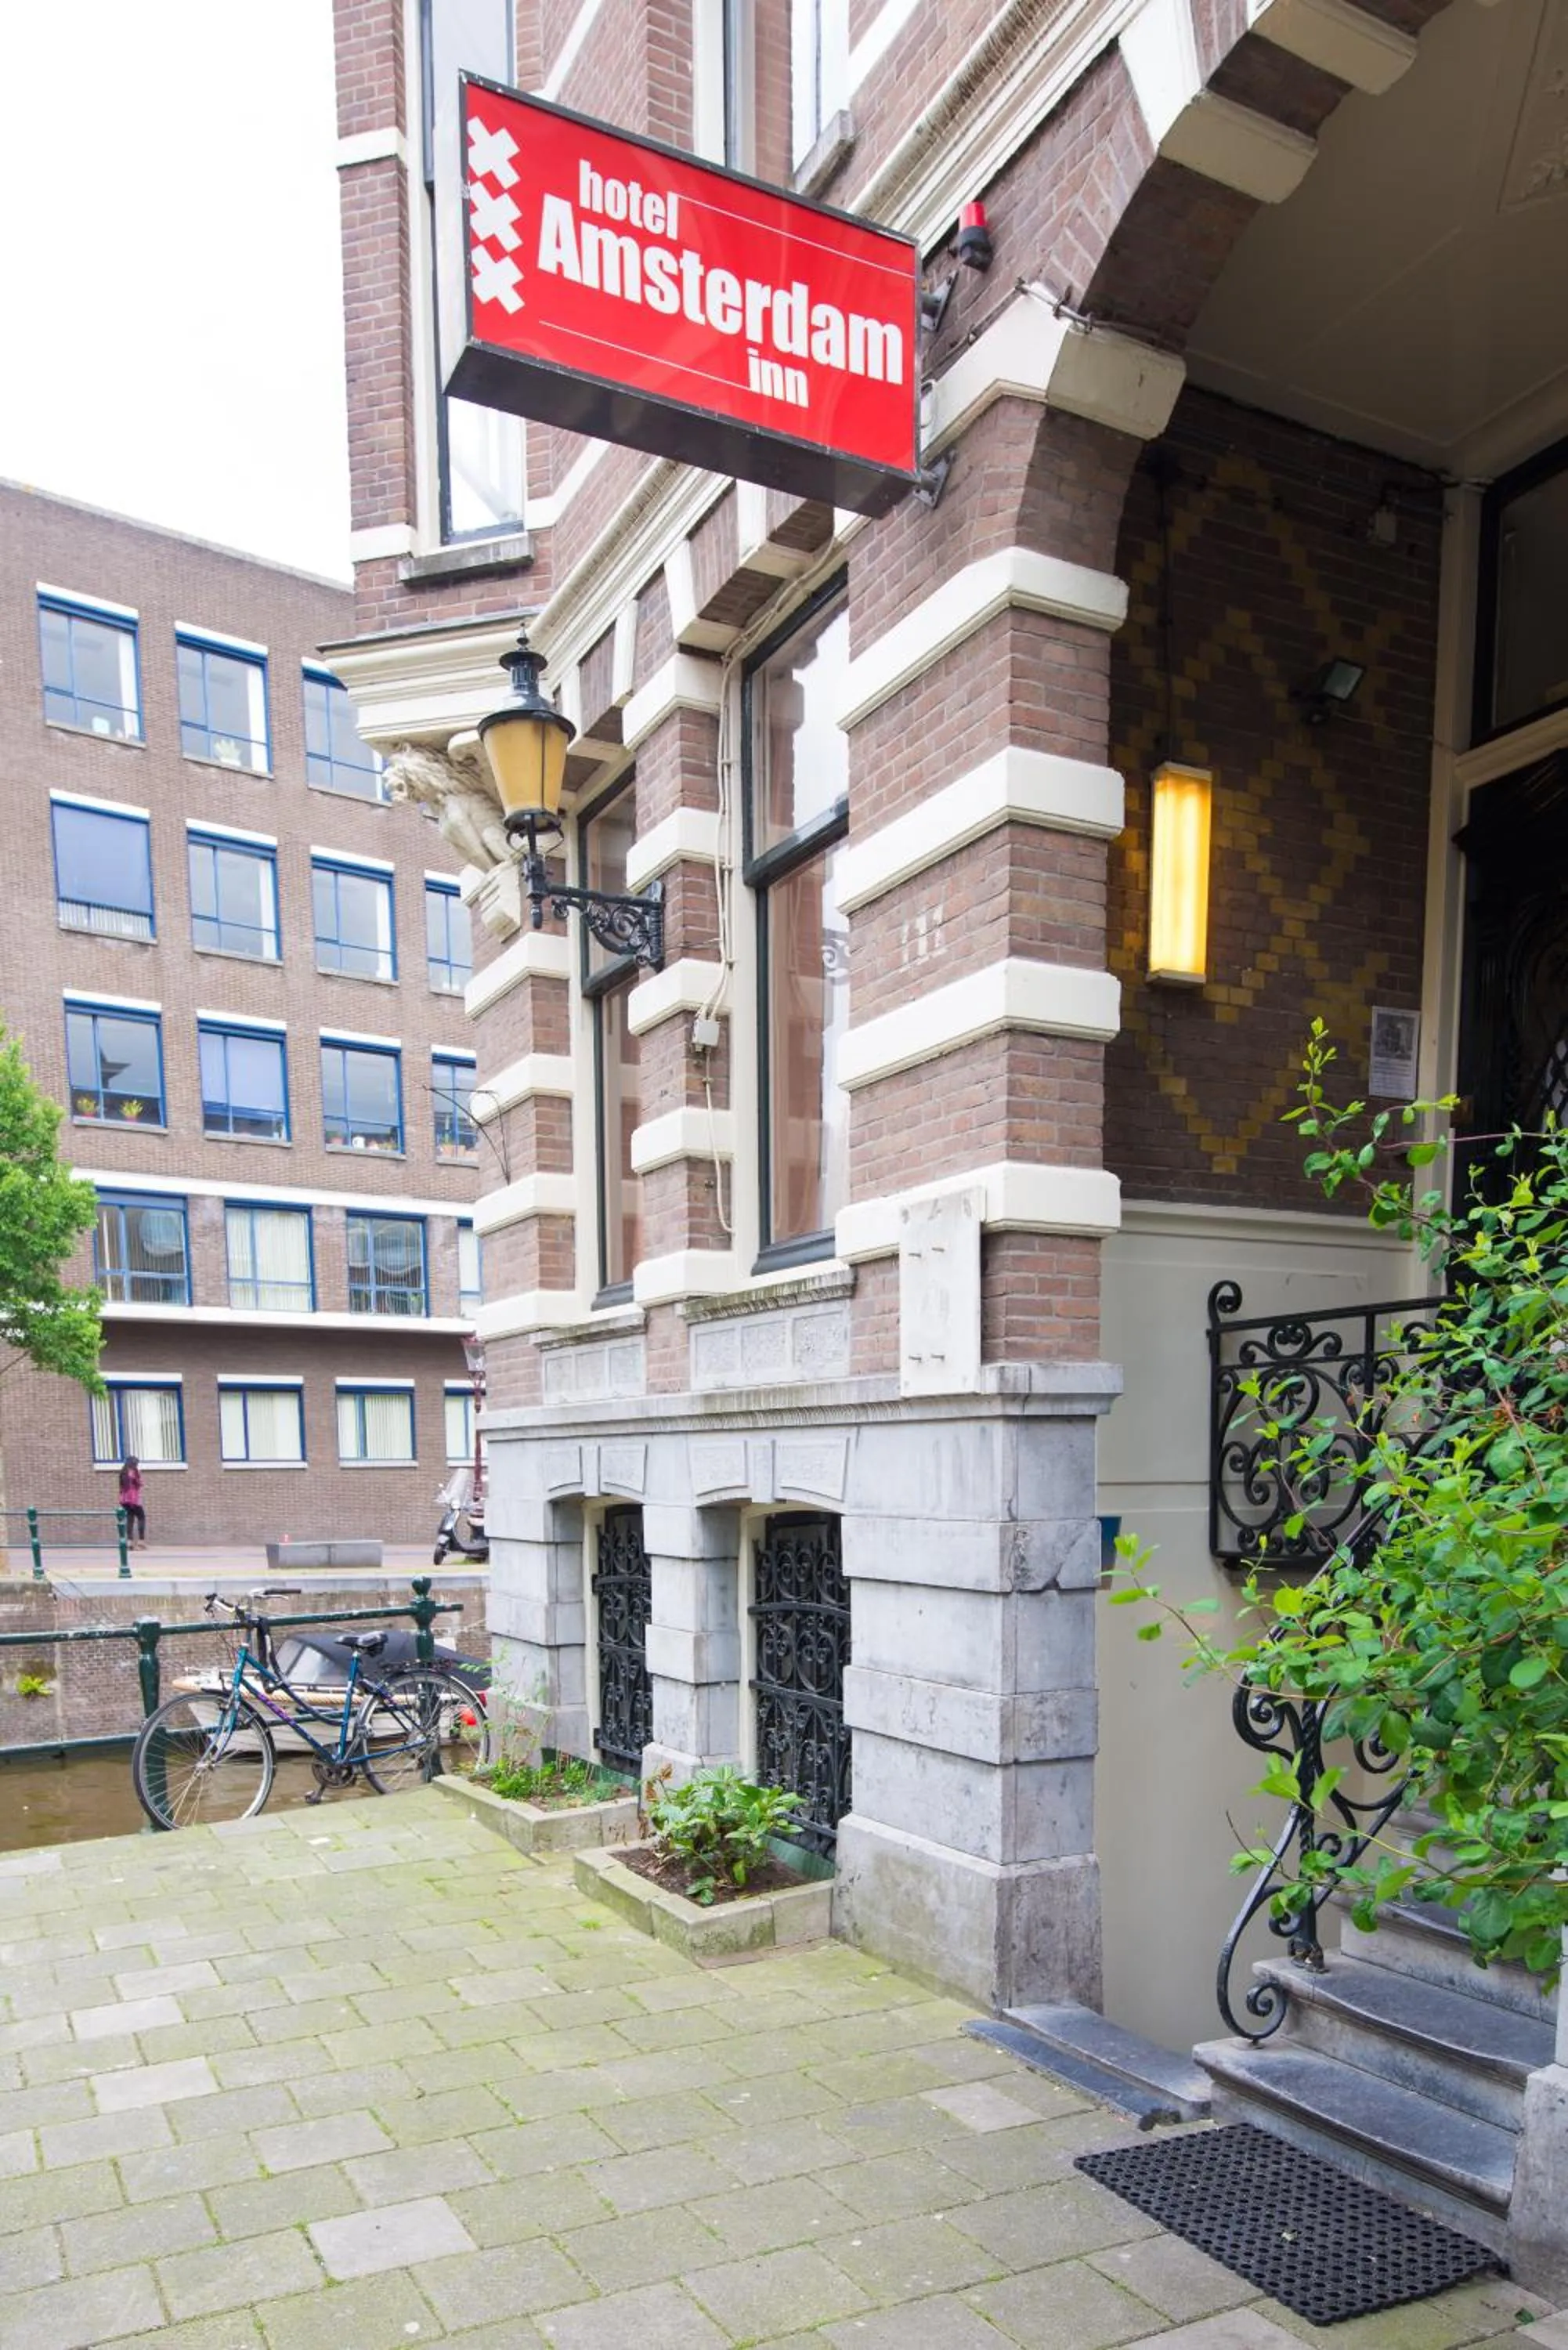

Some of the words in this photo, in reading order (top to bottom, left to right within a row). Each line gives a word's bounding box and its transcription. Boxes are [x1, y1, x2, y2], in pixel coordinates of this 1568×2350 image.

[579, 159, 681, 240] hotel
[537, 193, 903, 385] Amsterdam
[747, 347, 809, 408] inn
